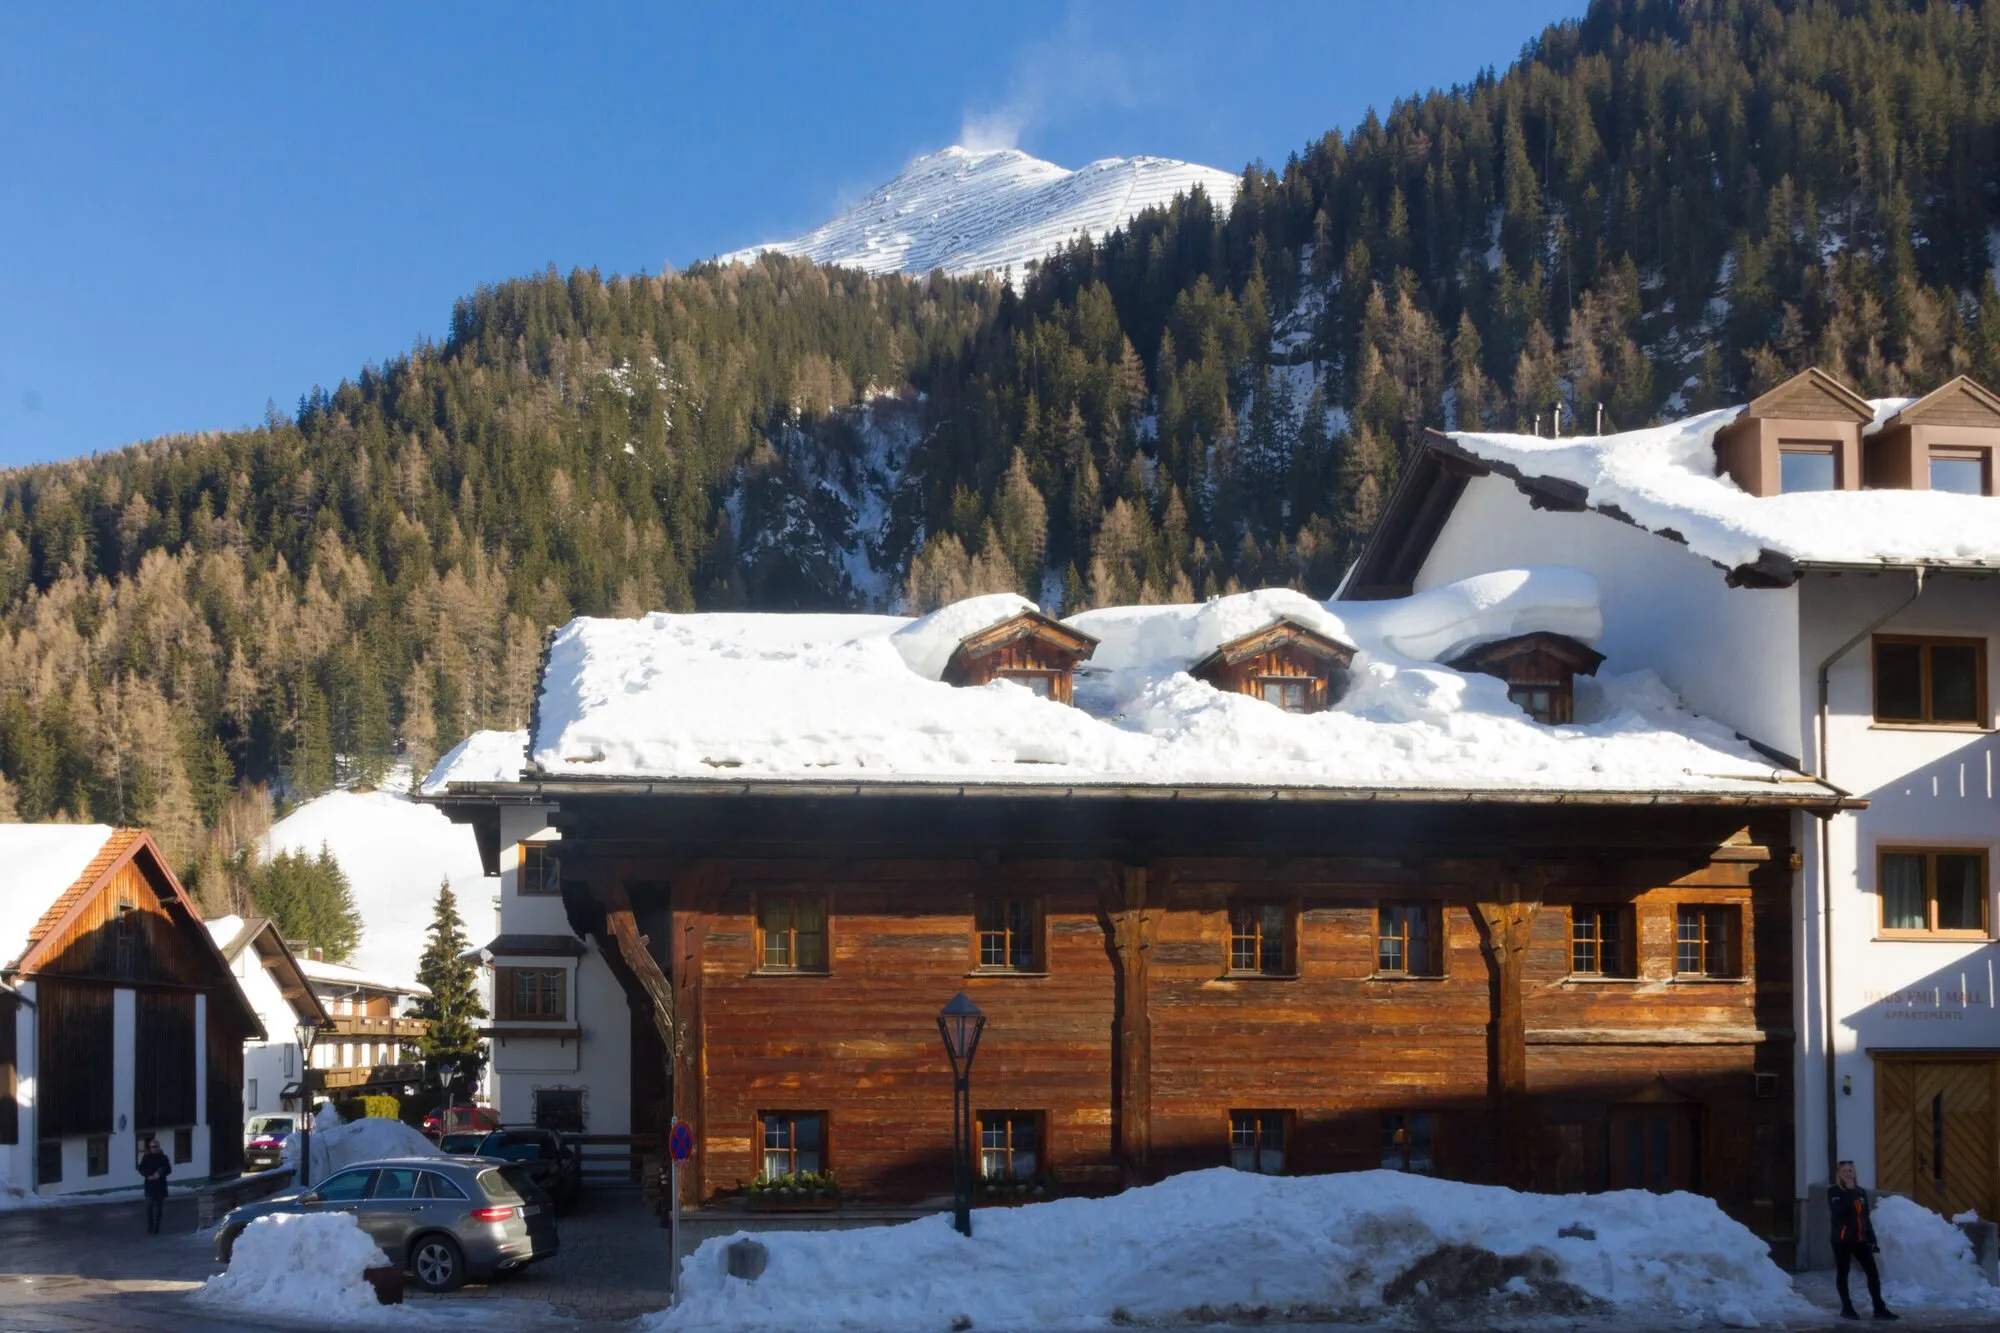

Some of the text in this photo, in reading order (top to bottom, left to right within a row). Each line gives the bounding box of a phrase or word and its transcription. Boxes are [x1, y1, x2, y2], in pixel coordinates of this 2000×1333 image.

[1864, 991, 1983, 1004] HAUS EMIL MALL
[1884, 1010, 1964, 1020] APPARTEMENTS
